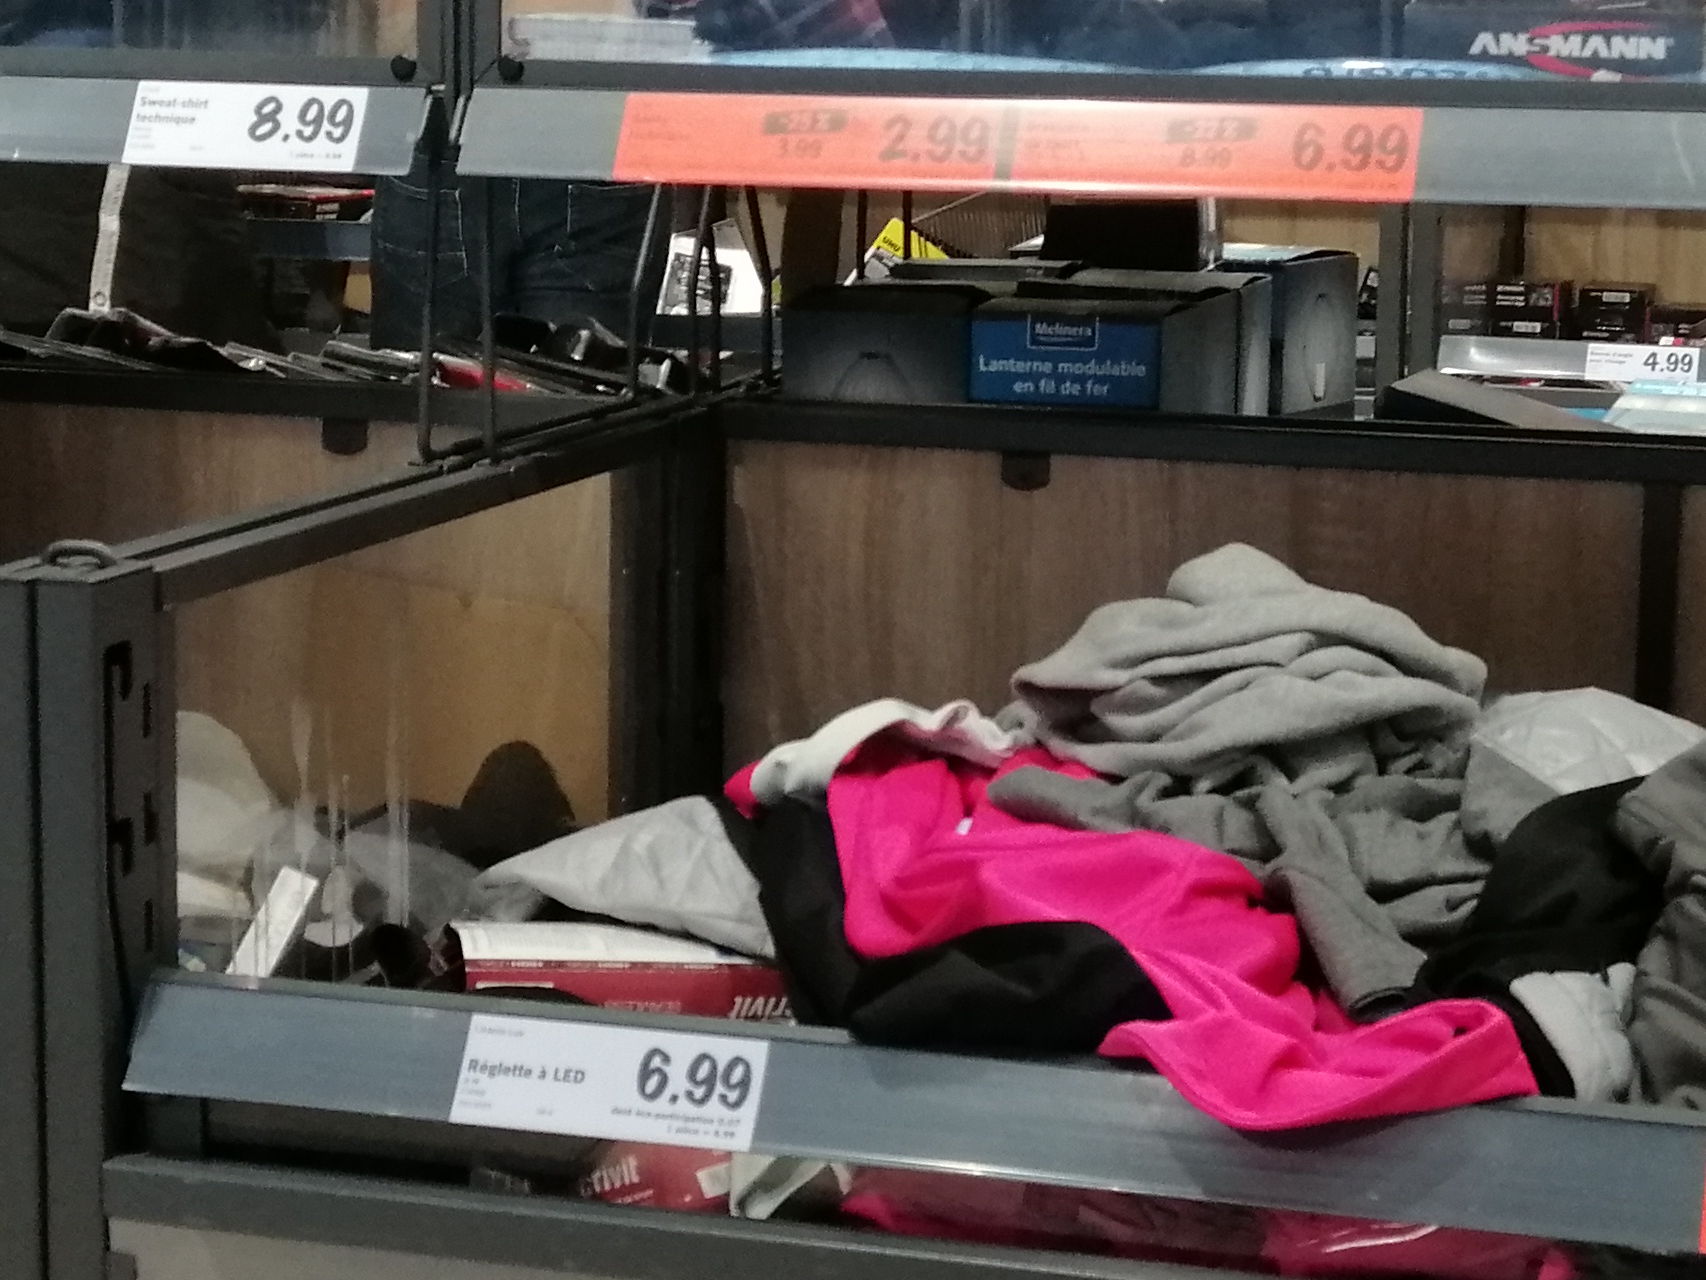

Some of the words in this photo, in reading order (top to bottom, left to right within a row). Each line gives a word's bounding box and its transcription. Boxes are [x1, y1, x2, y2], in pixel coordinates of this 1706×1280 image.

[1468, 31, 1667, 60] ANSMANN
[139, 95, 209, 110] Sweat-shirt
[136, 111, 196, 125] technique
[247, 95, 355, 144] 8.99
[878, 112, 991, 163] 2.99
[1293, 120, 1411, 173] 6.99
[1035, 322, 1093, 337] Melinera
[978, 354, 1053, 373] Lanterne
[1057, 355, 1147, 378] modulable
[1642, 351, 1694, 373] 4.99
[1012, 382, 1036, 394] en
[1039, 378, 1056, 394] fil
[1059, 379, 1082, 396] de
[1085, 381, 1110, 398] fer
[467, 1058, 533, 1080] Réglette
[537, 1064, 548, 1081] à
[552, 1066, 586, 1085] LED
[635, 1046, 752, 1110] 6.99
